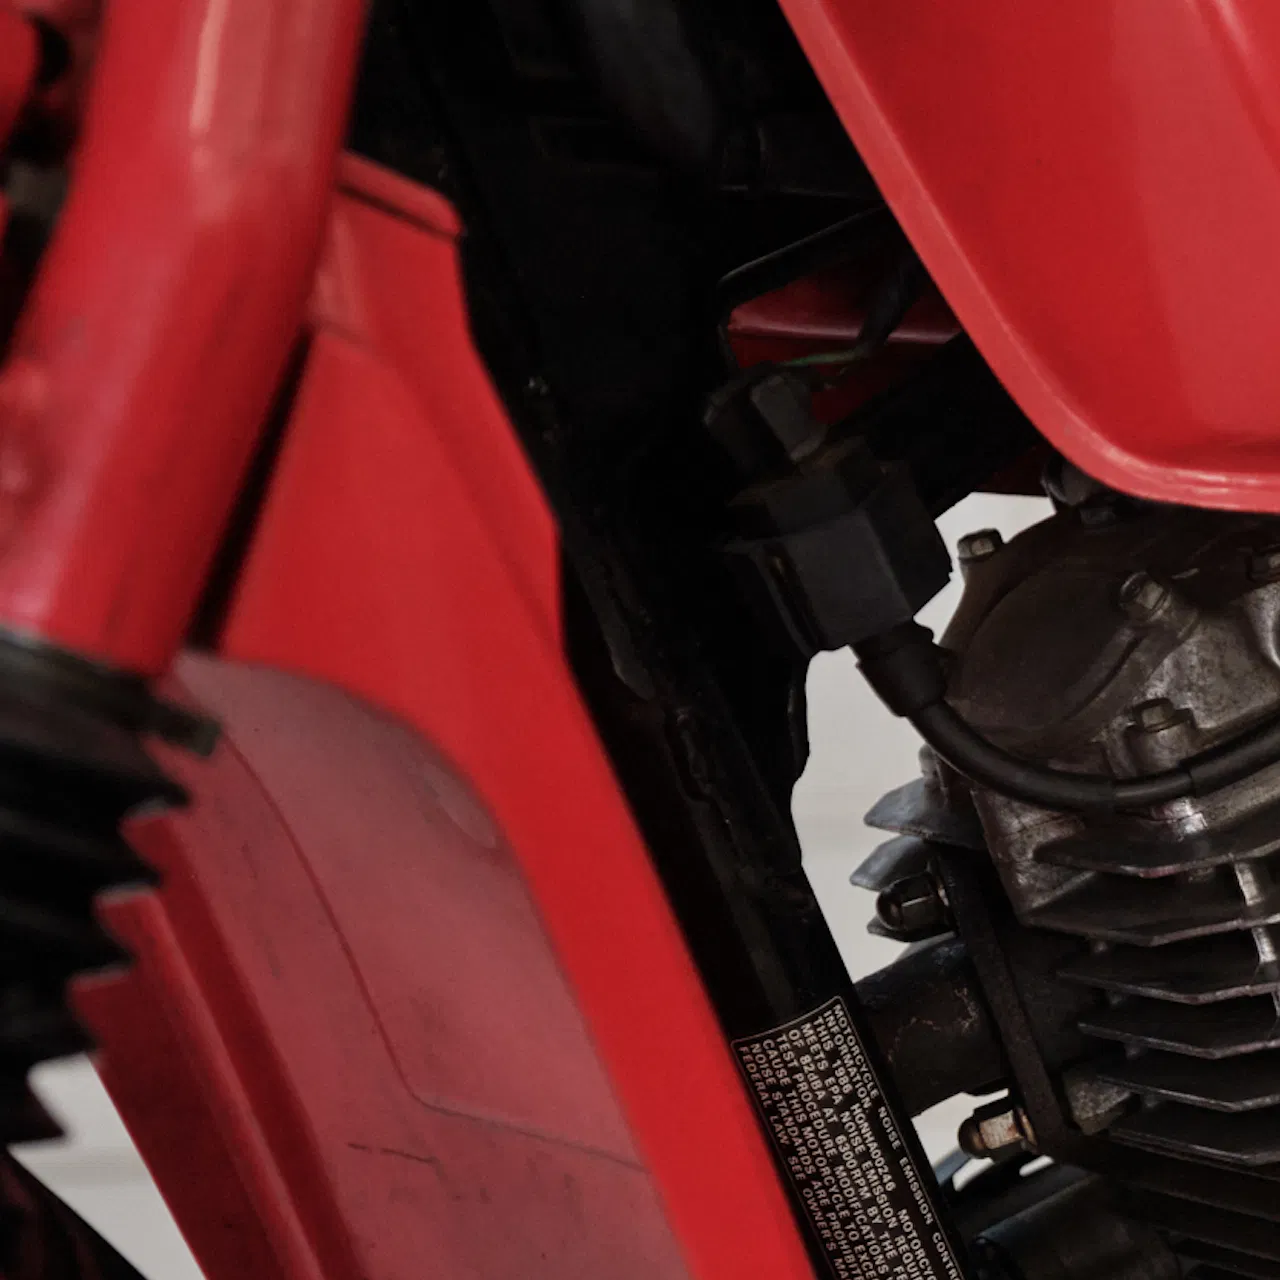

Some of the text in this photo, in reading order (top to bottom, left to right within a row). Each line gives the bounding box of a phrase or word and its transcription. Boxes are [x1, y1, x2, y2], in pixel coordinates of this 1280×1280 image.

[738, 1046, 773, 1108] FEDERAL
[787, 1155, 806, 1180] SEE
[750, 1043, 777, 1085] NOISE
[771, 1091, 817, 1175] STANDARDS
[811, 1180, 831, 1207] ARE
[762, 1039, 792, 1086] CAUSE
[785, 1089, 808, 1123] THIS
[801, 1126, 851, 1219] MOTORCYCLE
[844, 1221, 860, 1242] TO
[776, 1033, 800, 1068] TEST
[833, 1164, 890, 1275] MODIFICATIONS
[788, 1029, 806, 1048] OF
[822, 1107, 839, 1123] AT
[866, 1205, 883, 1224] BY
[879, 1231, 898, 1259] THE
[800, 1022, 829, 1071] MEETS
[823, 1076, 843, 1105] EPA
[839, 1110, 866, 1155] NOISE
[861, 1160, 899, 1229] EMISSION
[813, 1016, 835, 1052] THIS
[831, 1059, 853, 1094] 1986
[833, 1003, 879, 1099] MOTORCYCLE
[877, 1106, 901, 1150] NOISE
[899, 1156, 934, 1225] EMISSION
